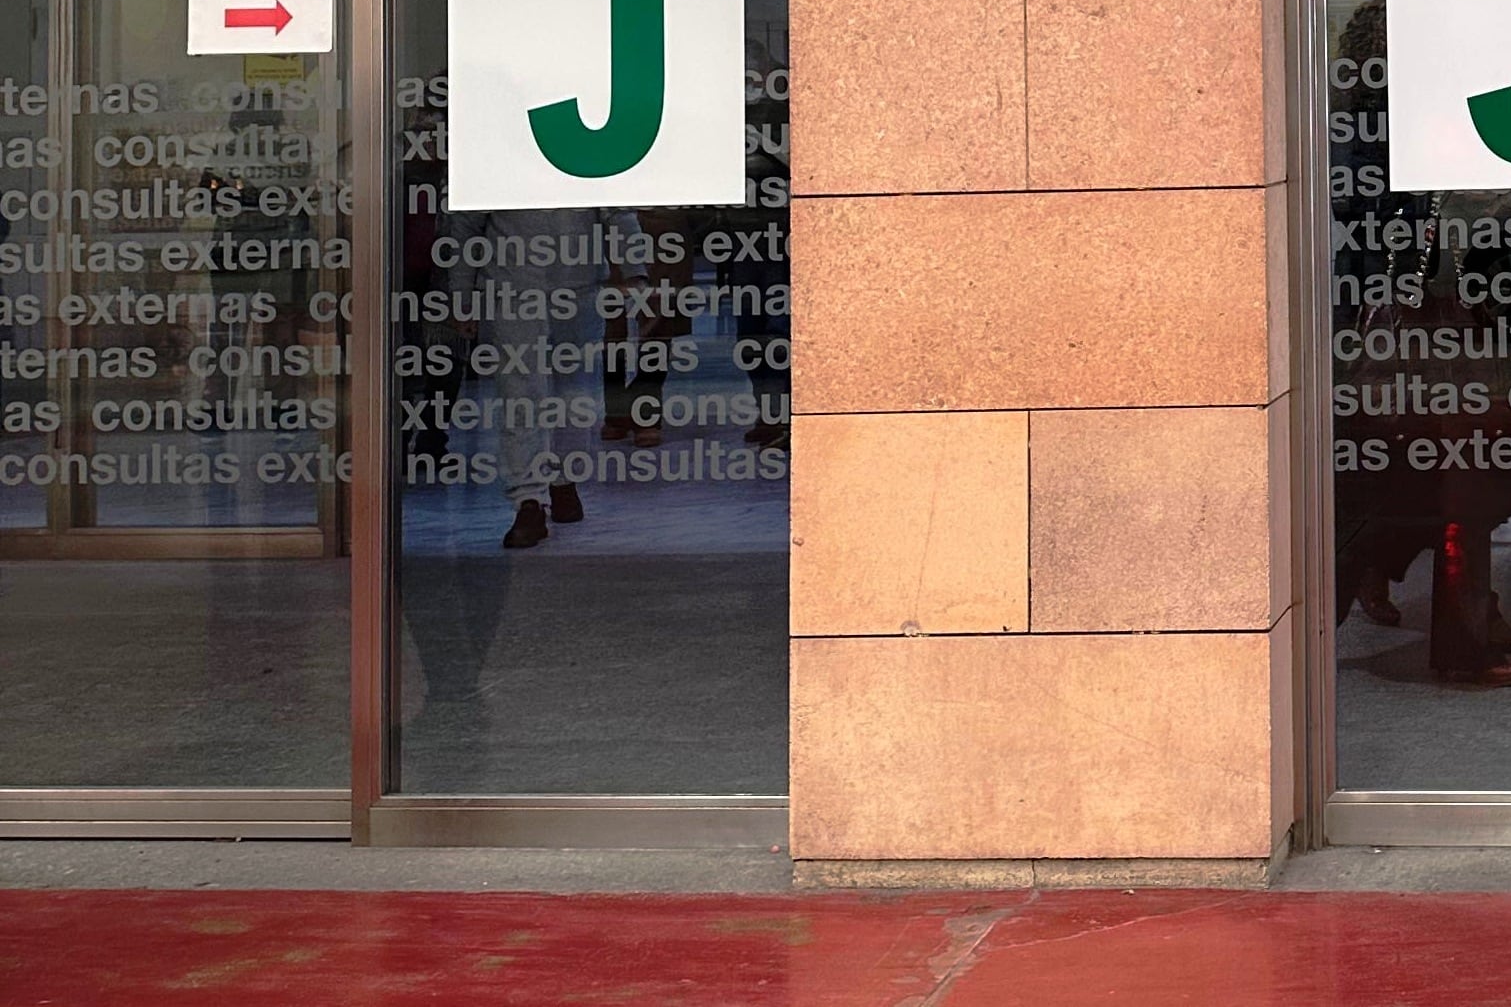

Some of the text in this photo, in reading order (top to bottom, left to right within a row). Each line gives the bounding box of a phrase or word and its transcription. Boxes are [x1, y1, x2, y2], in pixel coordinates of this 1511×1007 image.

[0, 134, 61, 169] as
[1, 178, 242, 222] consultas
[430, 223, 687, 269] consultas
[57, 287, 278, 326] externas
[469, 335, 700, 377] externas
[91, 389, 337, 433] consultas
[0, 444, 242, 487] consultas
[528, 439, 786, 484] consultas
